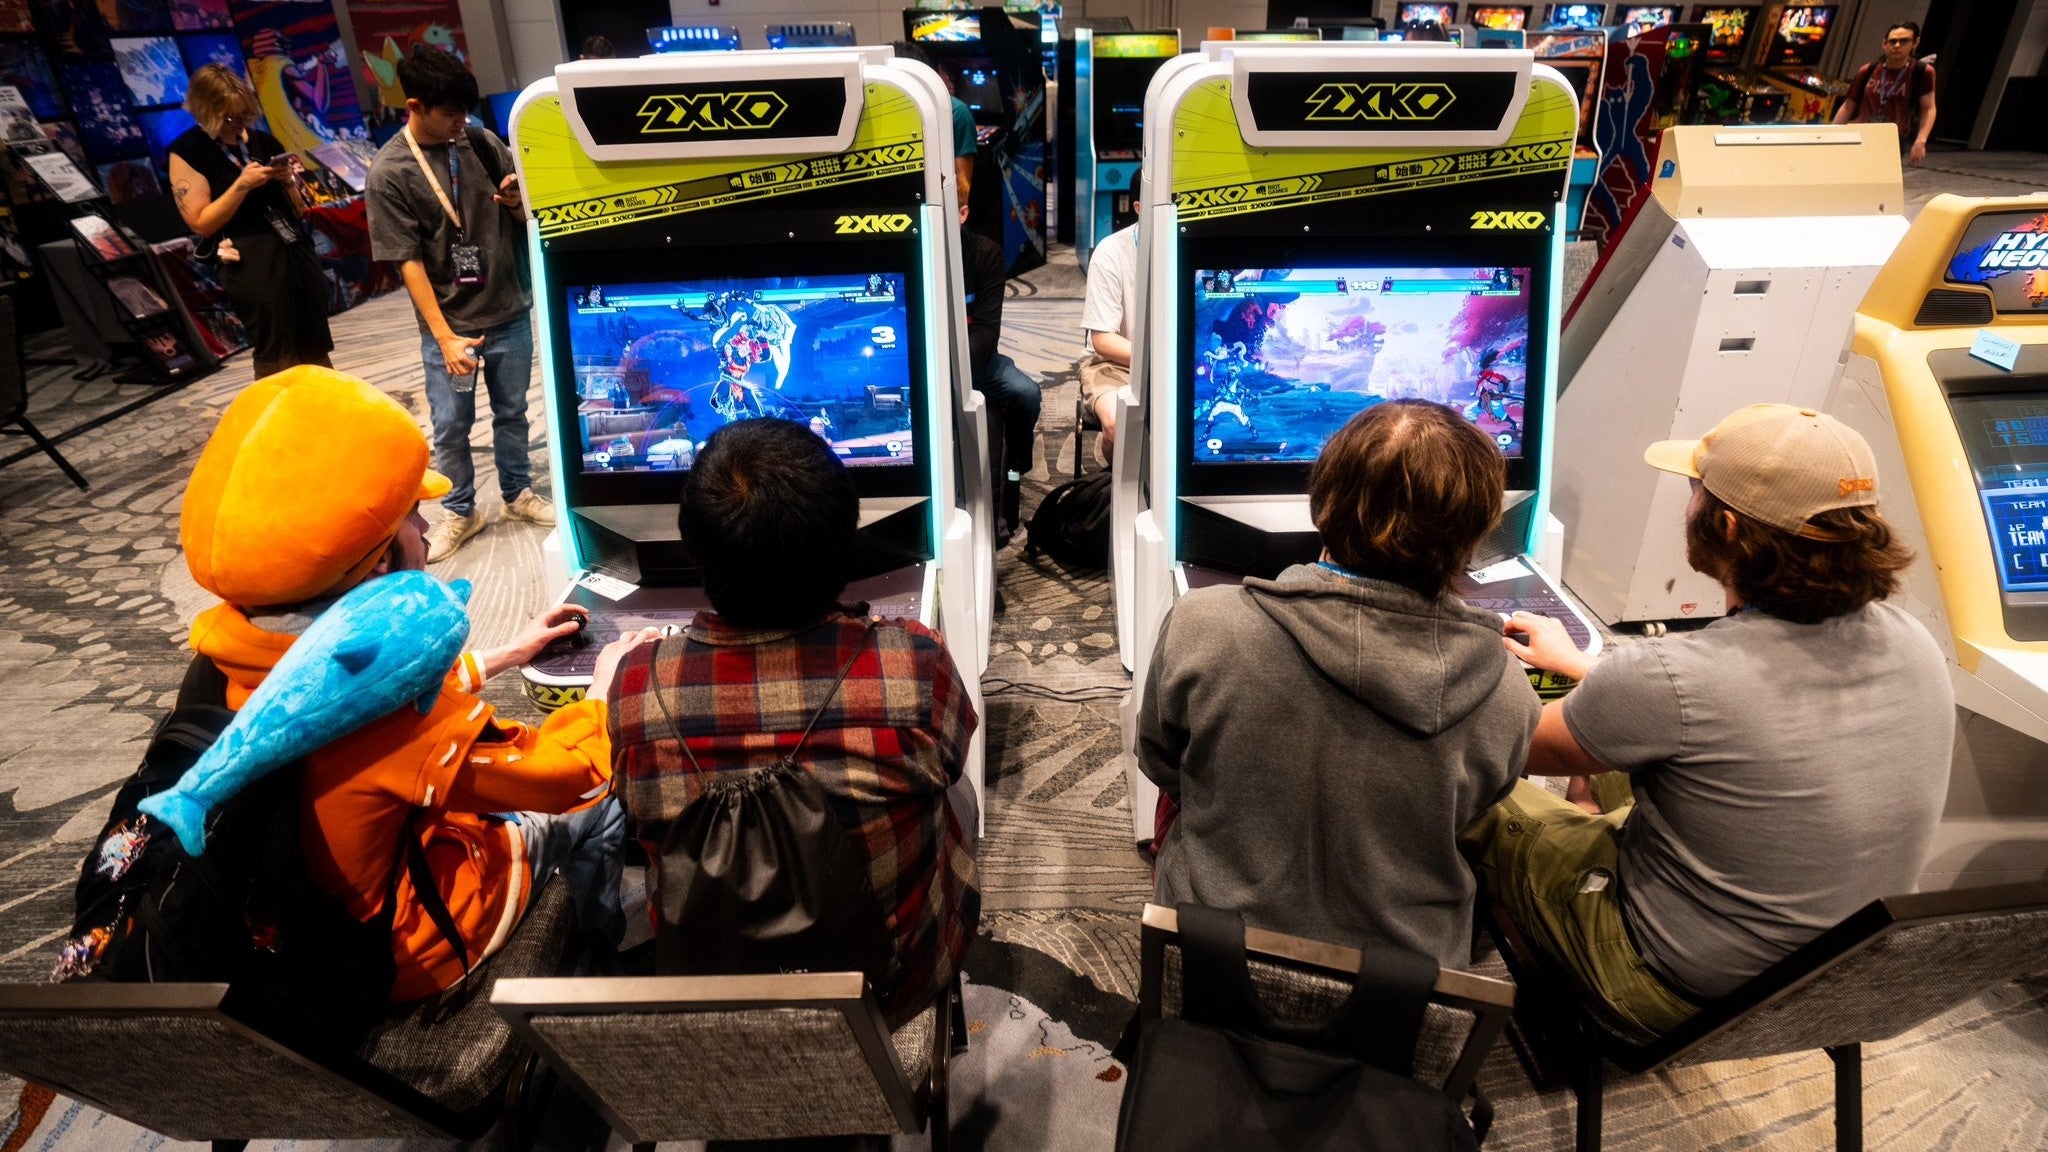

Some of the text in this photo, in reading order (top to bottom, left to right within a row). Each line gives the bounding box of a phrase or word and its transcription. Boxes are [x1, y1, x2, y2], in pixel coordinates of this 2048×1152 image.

[1304, 83, 1457, 120] 2XKO
[636, 91, 788, 133] 2XKO
[842, 143, 911, 171] 2XKO
[1490, 142, 1559, 166] 2XKO
[749, 170, 777, 185] 始動
[1395, 164, 1423, 177] 始動
[1458, 172, 1481, 181] 2XKO
[815, 177, 837, 187] 2XKO
[1177, 185, 1246, 210] 2XKO
[1268, 187, 1289, 195] GAMES
[1354, 187, 1377, 196] 2XKO
[713, 195, 735, 205] 2XKO
[1250, 201, 1273, 210] 2XKO
[539, 199, 605, 226] 2XKO
[612, 213, 635, 223] 2XKO
[834, 214, 913, 234] 2XKO
[1470, 211, 1546, 230] 2XKO
[1992, 232, 2048, 250] HY
[1351, 281, 1379, 291] 116
[871, 326, 896, 344] 3
[2003, 479, 2040, 488] TEAM
[2010, 500, 2046, 509] TEAM
[2008, 530, 2046, 546] TEAM
[534, 686, 587, 706] 2X
